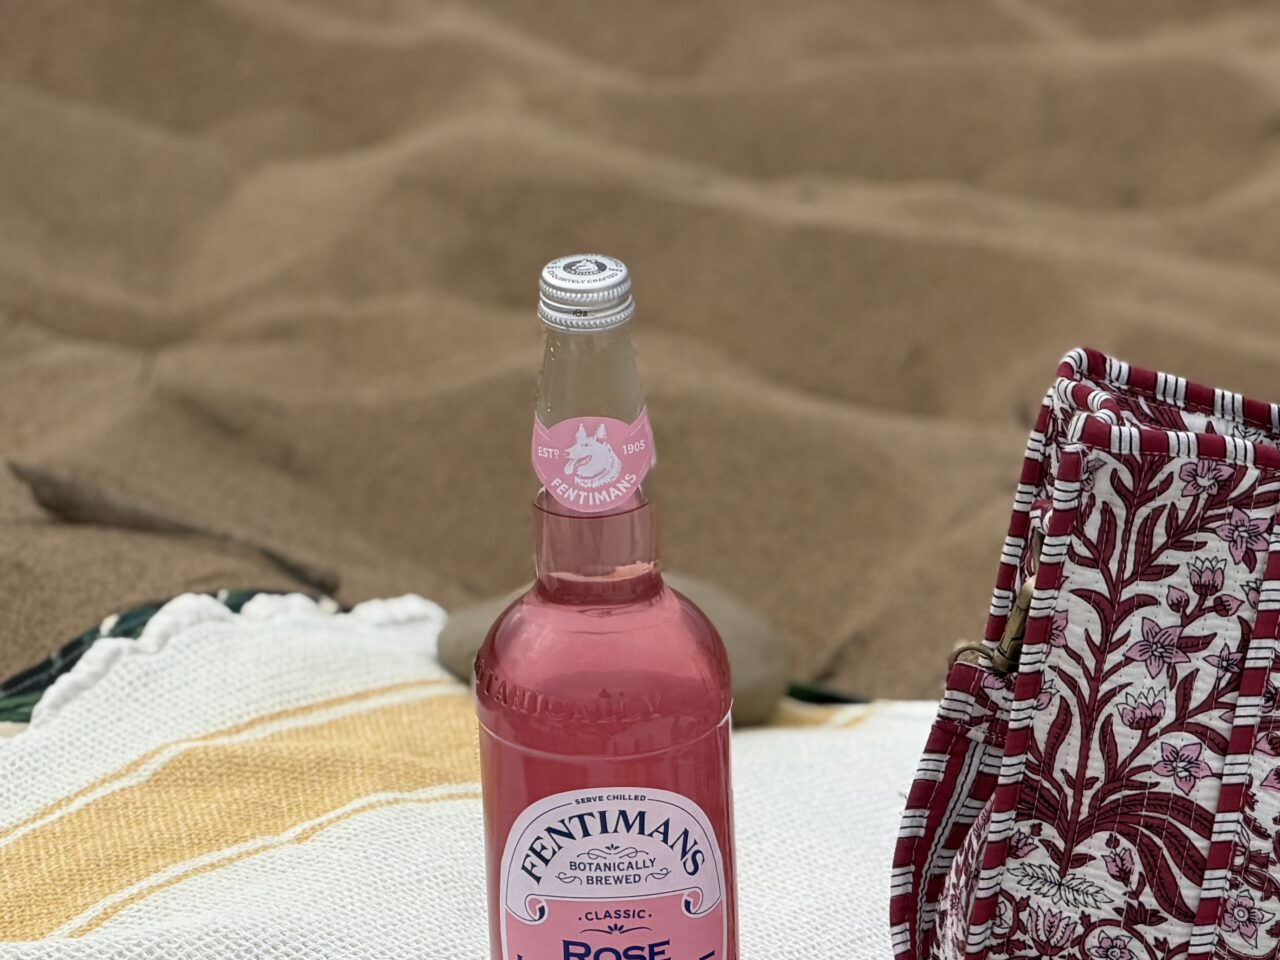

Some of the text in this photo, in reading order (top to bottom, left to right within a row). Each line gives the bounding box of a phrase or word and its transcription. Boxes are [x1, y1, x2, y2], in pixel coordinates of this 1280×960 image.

[622, 439, 646, 455] 1905
[551, 473, 637, 505] FENTIMANS
[575, 794, 647, 805] SERVE CHILLED
[521, 810, 705, 885] FENTIMANS
[569, 858, 656, 872] BOTANICALLY
[586, 874, 642, 885] BREWED
[585, 909, 646, 921] CLASSIC
